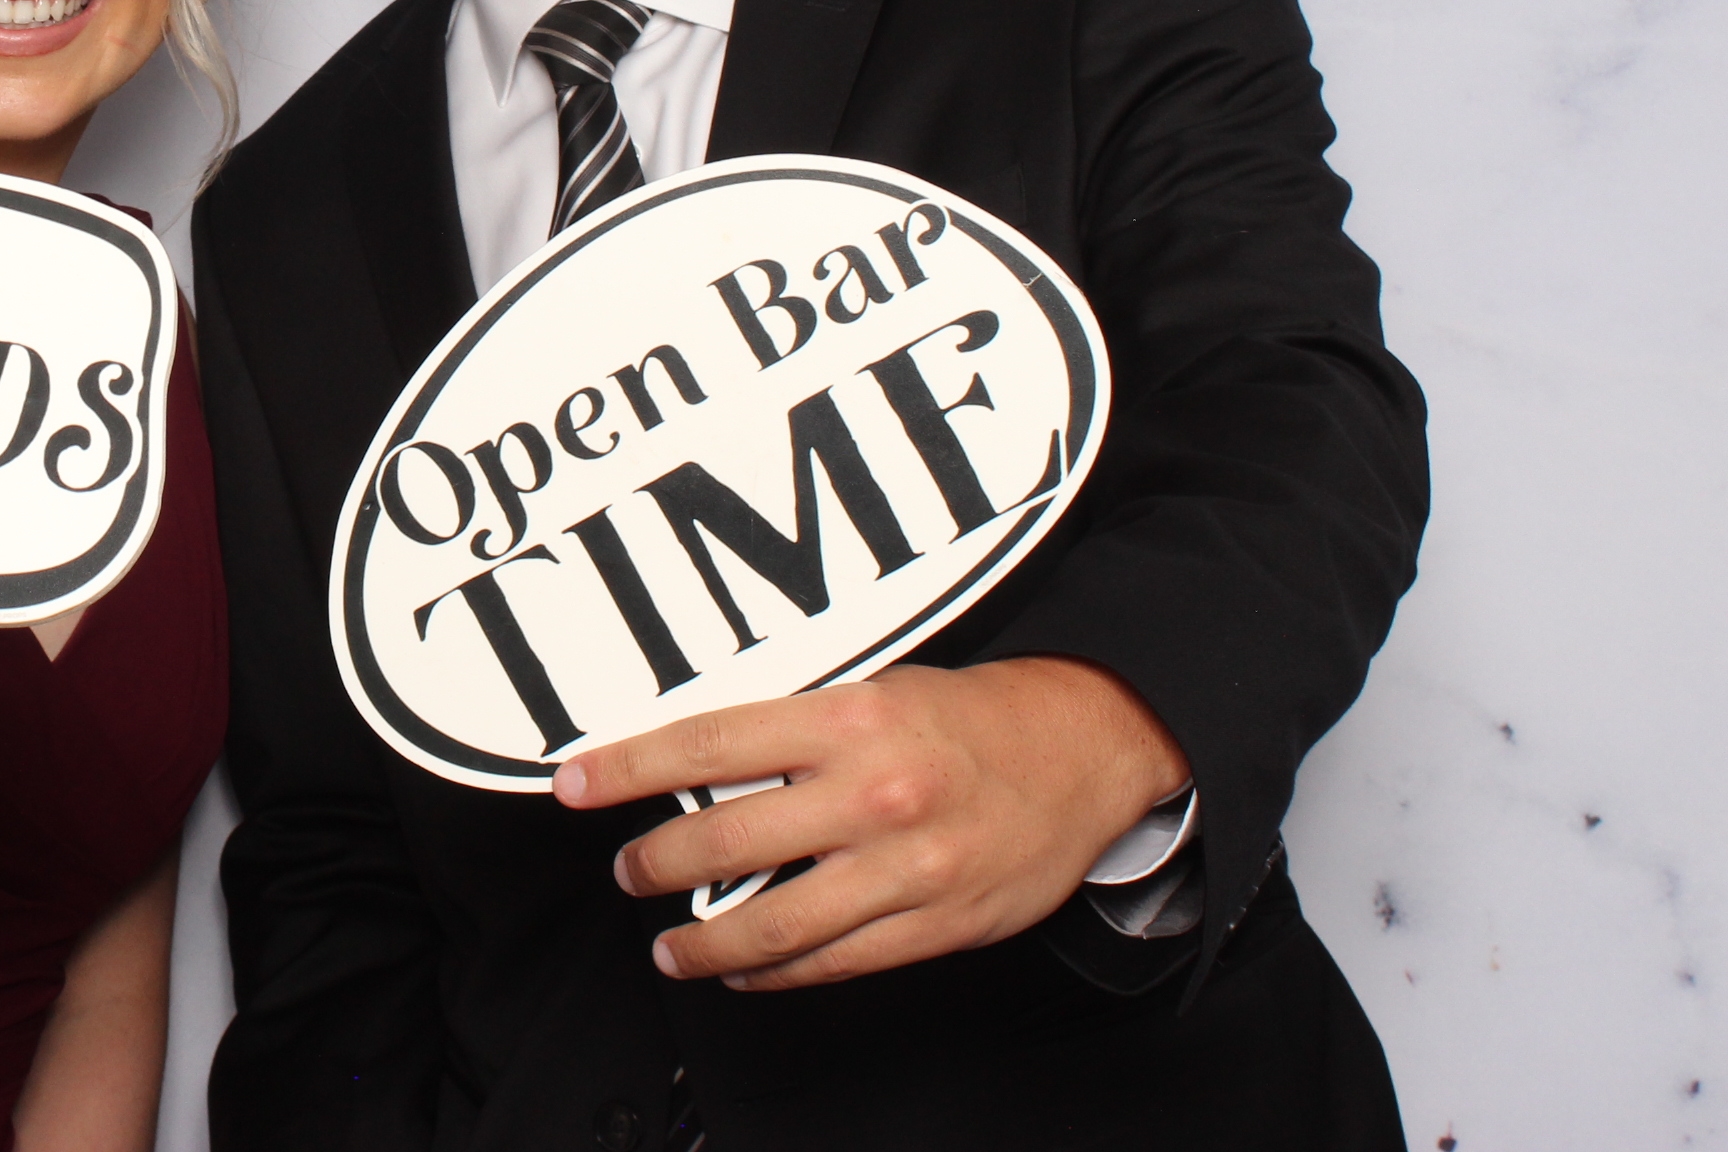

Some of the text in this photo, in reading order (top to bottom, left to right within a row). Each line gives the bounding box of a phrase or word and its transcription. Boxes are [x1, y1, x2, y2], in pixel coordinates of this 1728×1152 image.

[379, 202, 947, 561] Open Bar
[413, 309, 1062, 758] TIME
